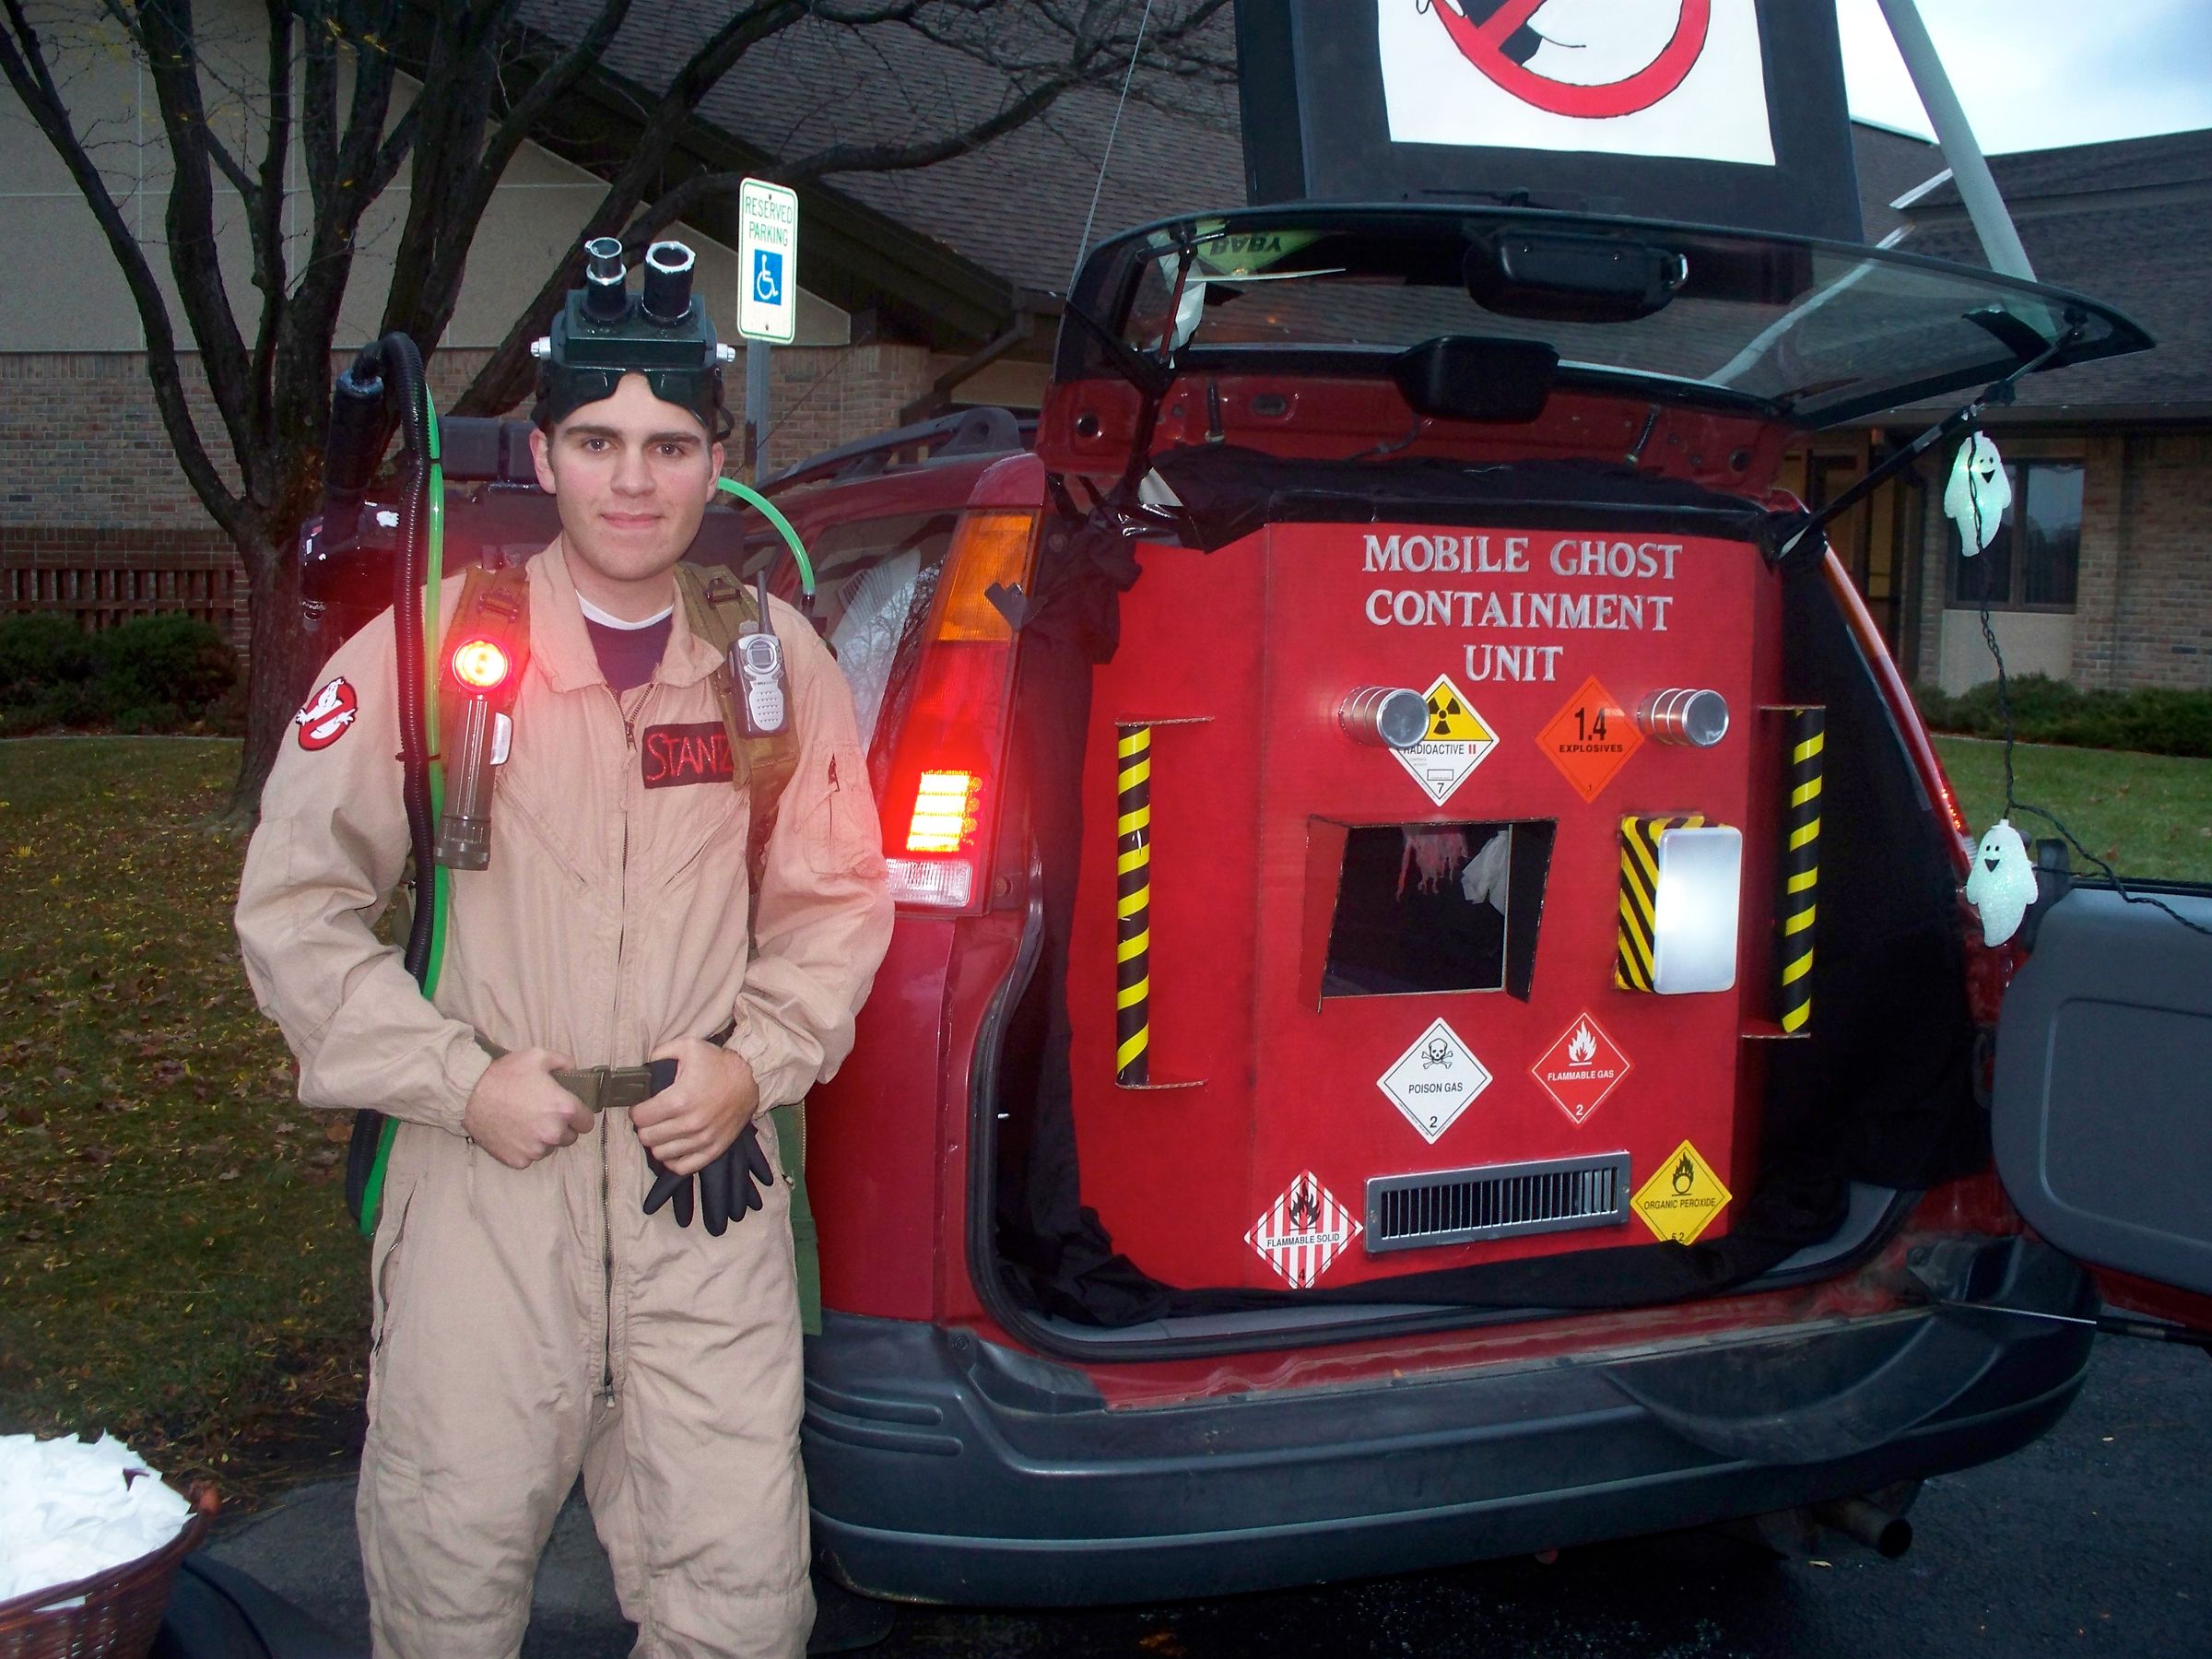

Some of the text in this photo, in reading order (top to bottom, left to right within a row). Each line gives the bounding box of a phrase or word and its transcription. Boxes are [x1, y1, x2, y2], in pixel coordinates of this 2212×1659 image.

[745, 195, 793, 224] RESERVED
[749, 221, 788, 247] PARKING
[1362, 535, 1683, 580] MOBILE GHOST
[1365, 588, 1674, 631] CONTAINMENT
[1464, 644, 1564, 682] UNIT
[1574, 707, 1606, 741] 1.4
[1559, 744, 1623, 753] EXPLOSIVES
[1437, 782, 1444, 794] 7
[1547, 1069, 1615, 1081] FLAMMABLE GAS
[1408, 1082, 1464, 1094] POISON GAS
[1576, 1104, 1583, 1116] 2
[1430, 1115, 1438, 1128] 2
[1643, 1197, 1716, 1210] ORGANIC PEROXIDE
[1267, 1233, 1340, 1247] FLAMMABLE SOLID
[1298, 1268, 1305, 1280] 4
